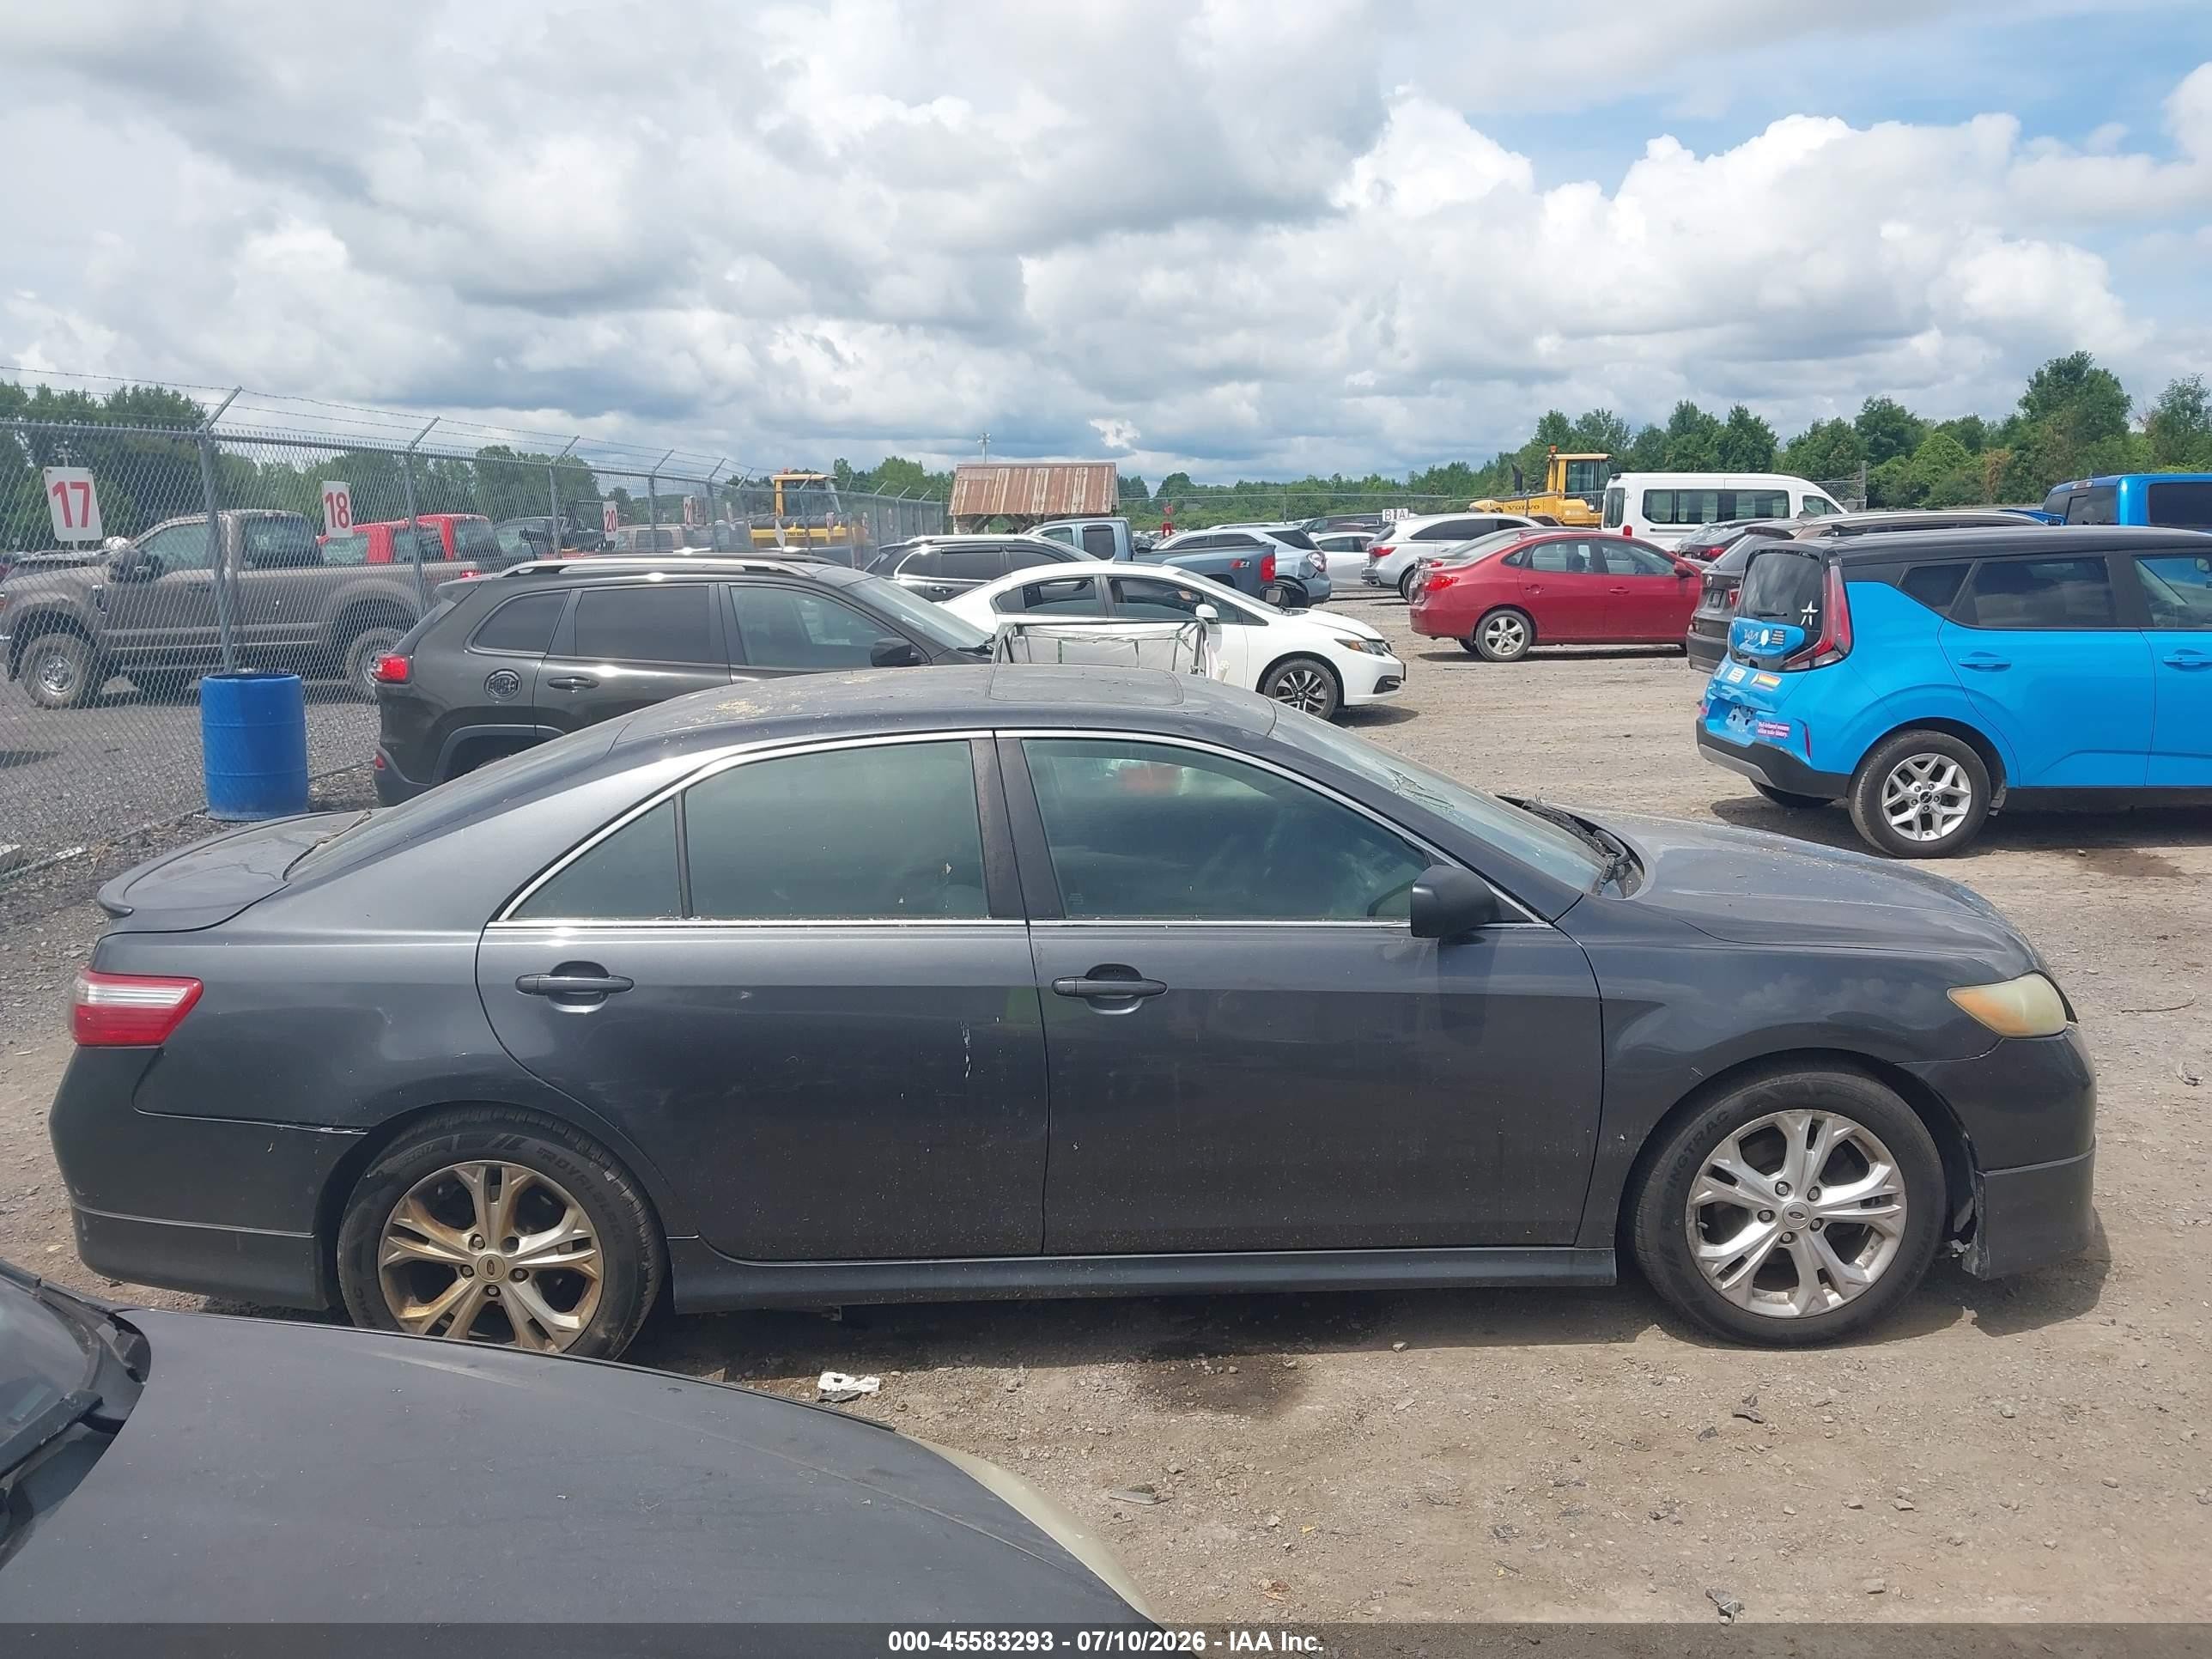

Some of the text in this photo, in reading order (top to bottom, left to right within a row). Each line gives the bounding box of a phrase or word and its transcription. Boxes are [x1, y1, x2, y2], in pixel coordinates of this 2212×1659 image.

[52, 480, 90, 528] 17
[324, 491, 349, 529] 18
[605, 510, 617, 532] 20
